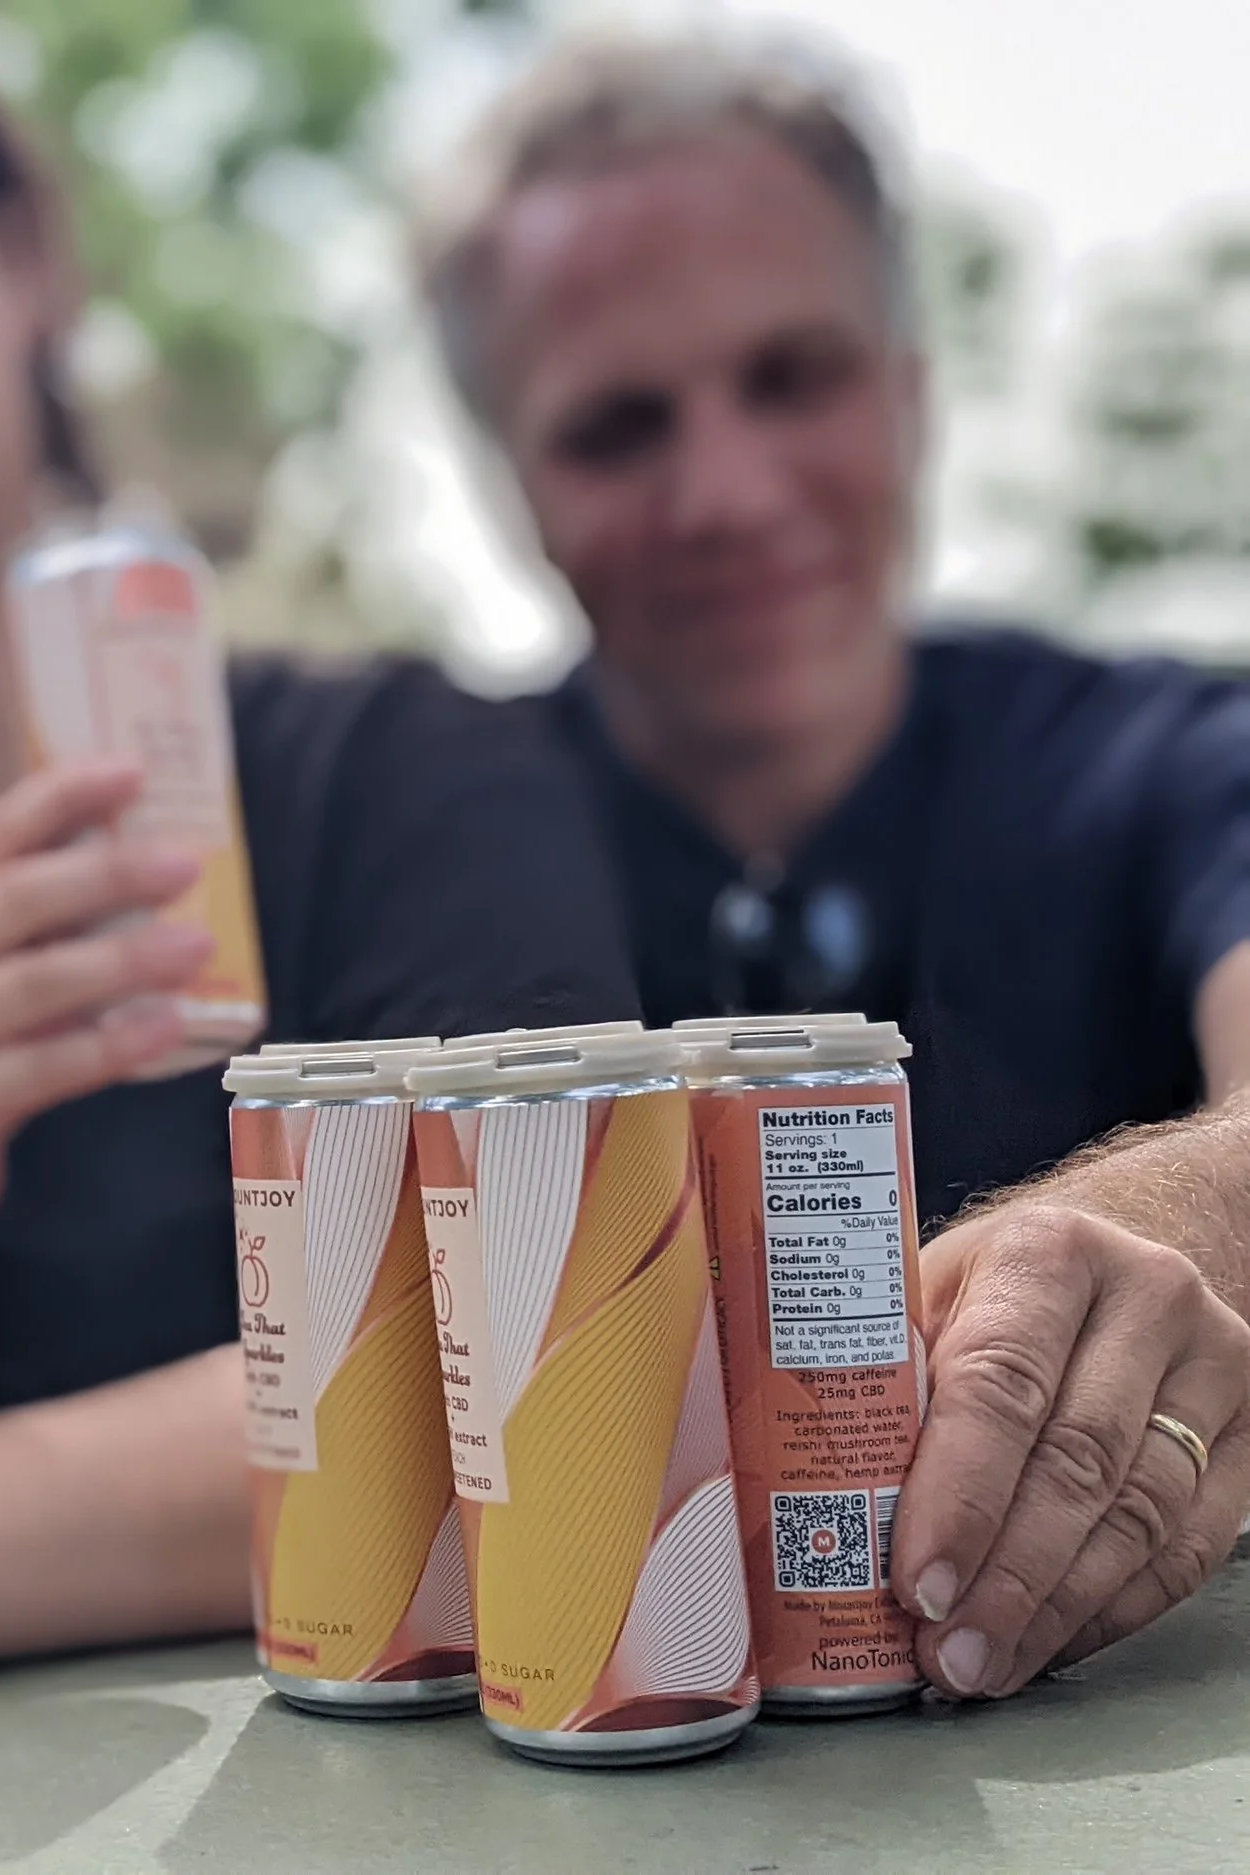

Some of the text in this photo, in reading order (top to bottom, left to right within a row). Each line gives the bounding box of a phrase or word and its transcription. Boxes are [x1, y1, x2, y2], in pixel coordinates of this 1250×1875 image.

[762, 1108, 894, 1128] Nutrition Facts
[765, 1132, 837, 1149] Servings: 1
[764, 1148, 847, 1162] Serving size
[766, 1160, 864, 1174] 11 oz. (330ml)
[765, 1180, 851, 1192] Amount per serving
[766, 1189, 898, 1212] Calories 0
[877, 1215, 899, 1227] Value
[769, 1232, 899, 1248] Total Fat 0g 0%
[769, 1249, 900, 1266] Sodium 0g 0%
[770, 1266, 902, 1281] Cholesterol 0g 0%
[771, 1282, 903, 1298] Total Carb. 0g 0%
[772, 1299, 903, 1315] Protein 0g 0%
[254, 1313, 286, 1335] That
[775, 1325, 795, 1336] Not
[797, 1327, 805, 1336] a
[808, 1322, 860, 1337] significant
[862, 1321, 891, 1333] source
[443, 1331, 470, 1356] That
[775, 1341, 796, 1351] sat.
[819, 1340, 847, 1350] trans
[776, 1354, 823, 1366] calcium,
[825, 1353, 849, 1364] iron,
[851, 1351, 870, 1362] and
[799, 1368, 897, 1384] 250mg caffeine
[818, 1385, 885, 1400] 25mg CBD
[452, 1397, 469, 1412] CBD
[776, 1410, 860, 1423] Ingredients:
[864, 1405, 893, 1419] black
[794, 1423, 869, 1436] carbonated
[454, 1431, 488, 1448] extract
[783, 1440, 822, 1451] reishi
[827, 1436, 891, 1450] mushroom
[811, 1453, 858, 1465] natural
[780, 1468, 840, 1481] caffeine,
[845, 1466, 879, 1479] hemp
[818, 1535, 830, 1547] M
[819, 1631, 881, 1650] powered
[501, 1663, 554, 1681] SUGAR
